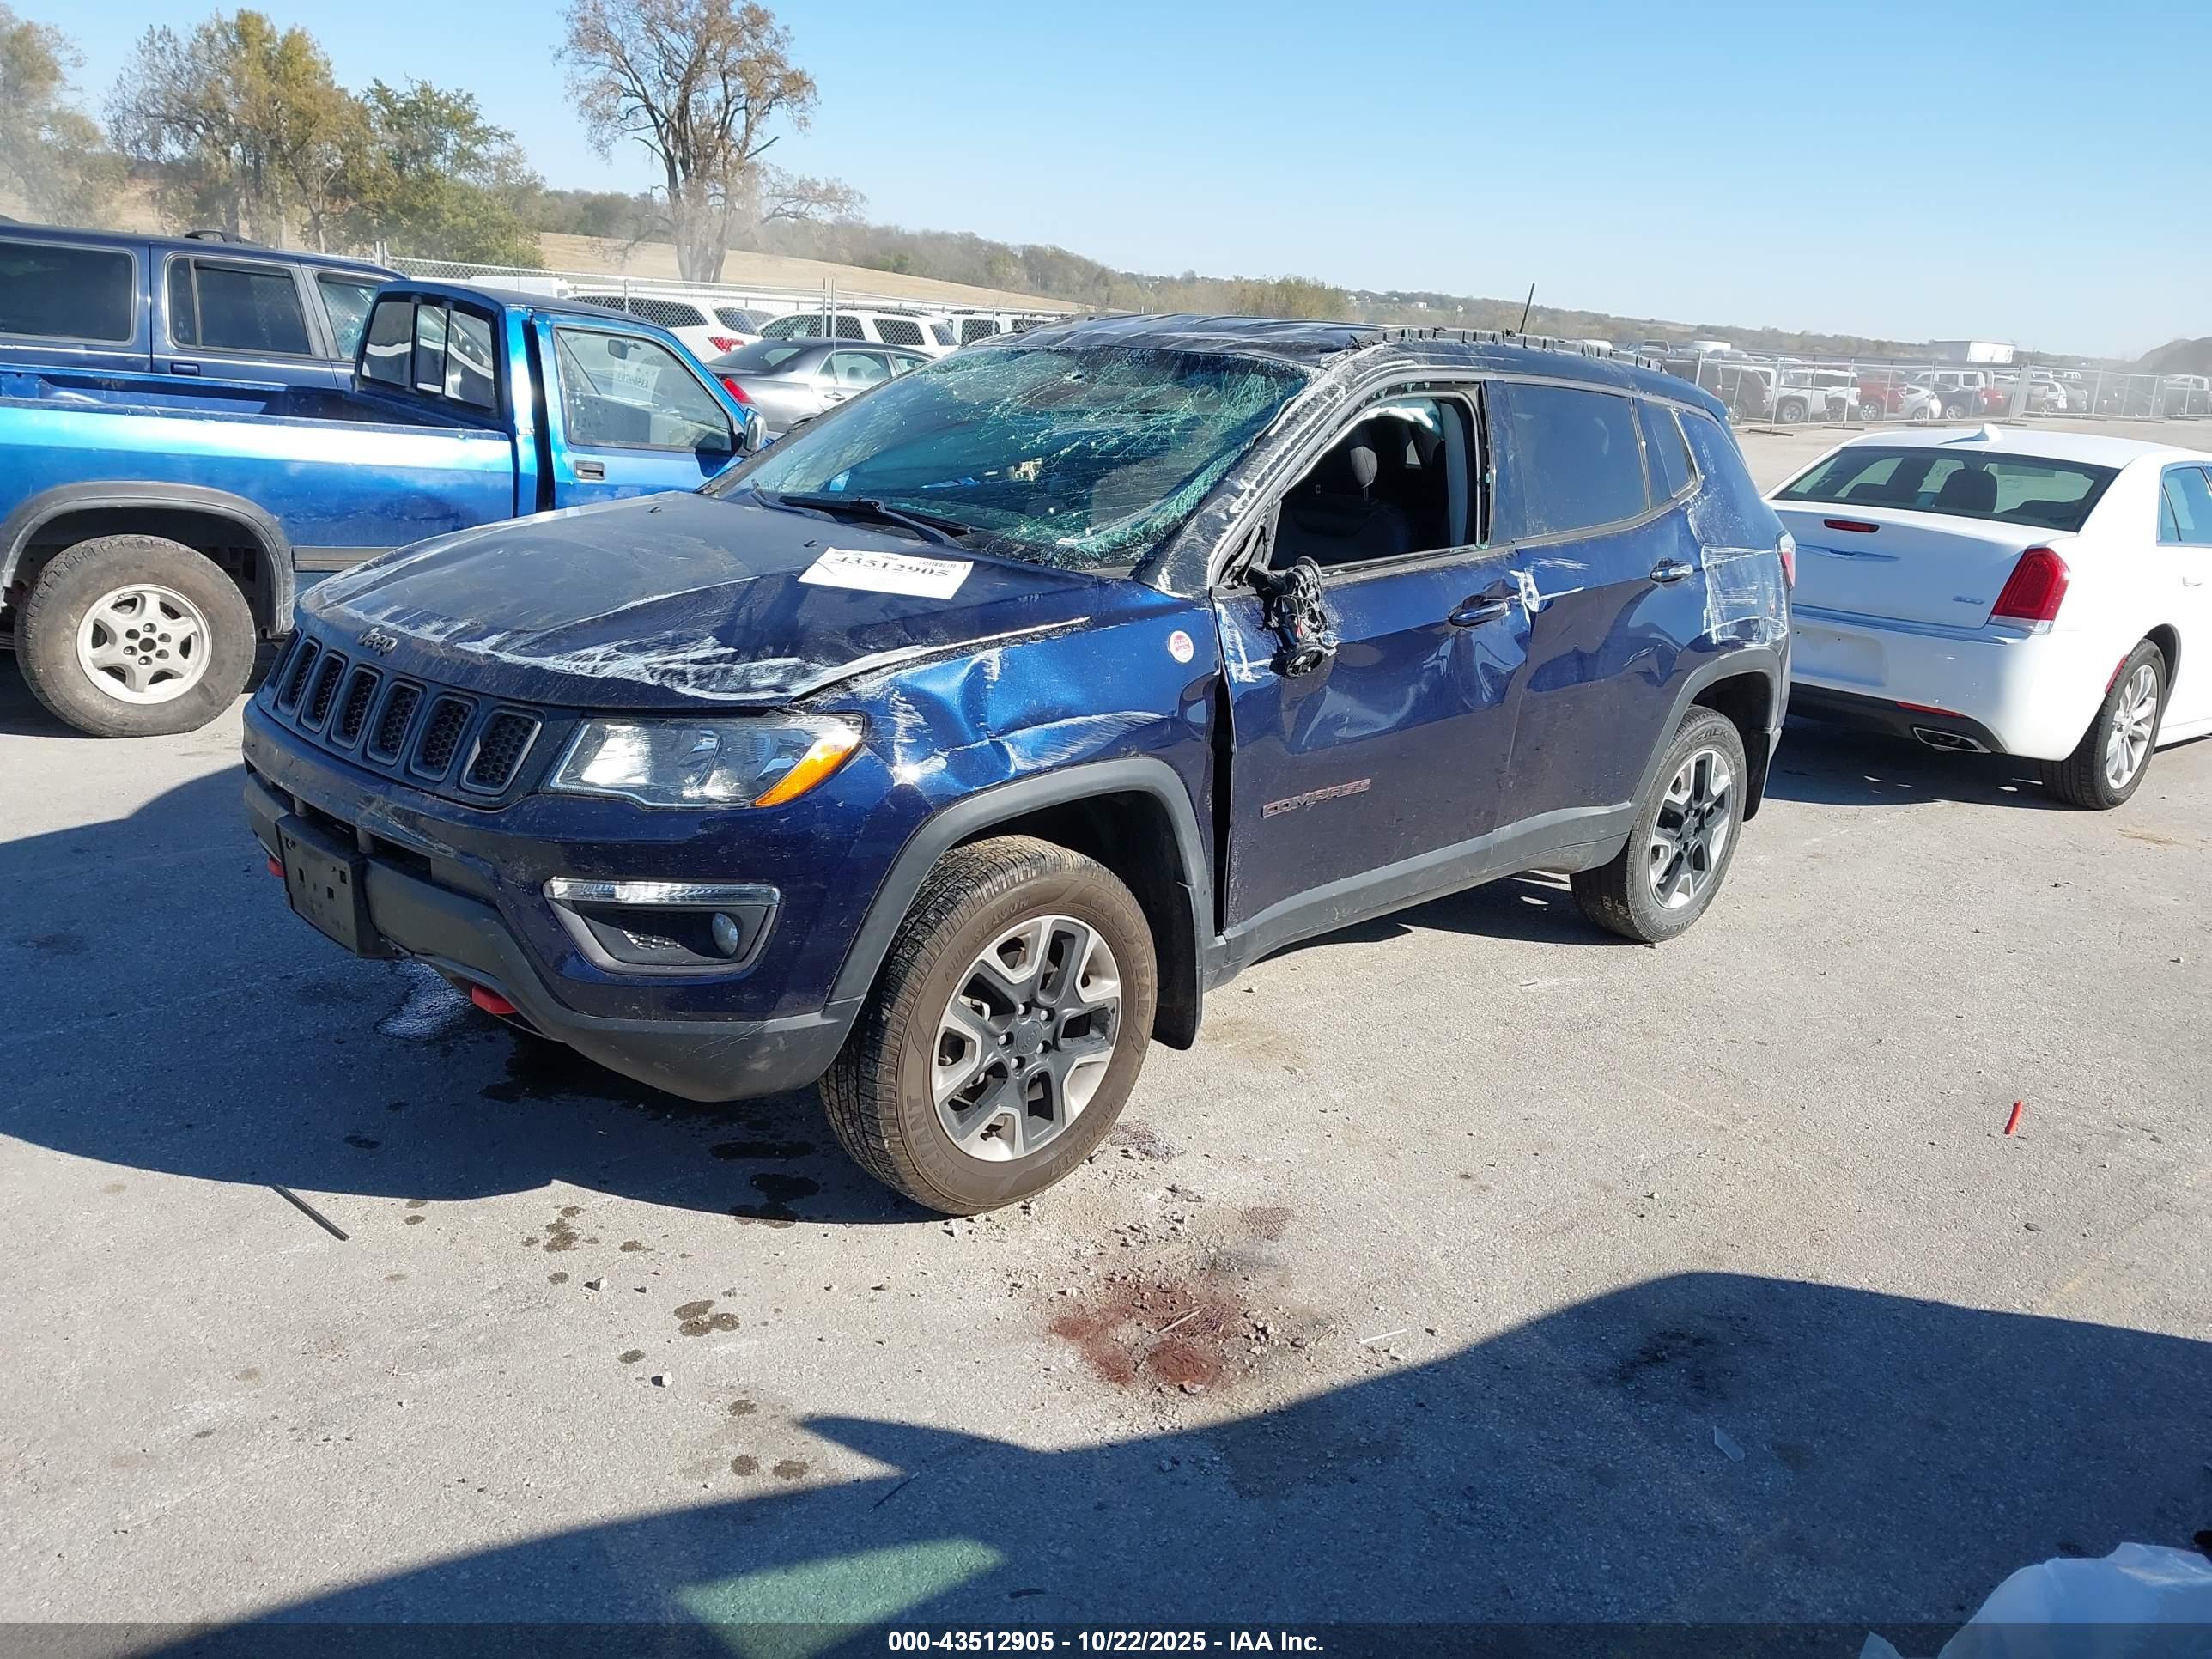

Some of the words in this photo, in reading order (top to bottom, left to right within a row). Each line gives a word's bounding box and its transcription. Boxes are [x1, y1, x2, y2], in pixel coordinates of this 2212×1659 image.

[835, 556, 951, 577] 43512905
[357, 627, 399, 656] Jeep
[1261, 777, 1372, 819] COMPASS
